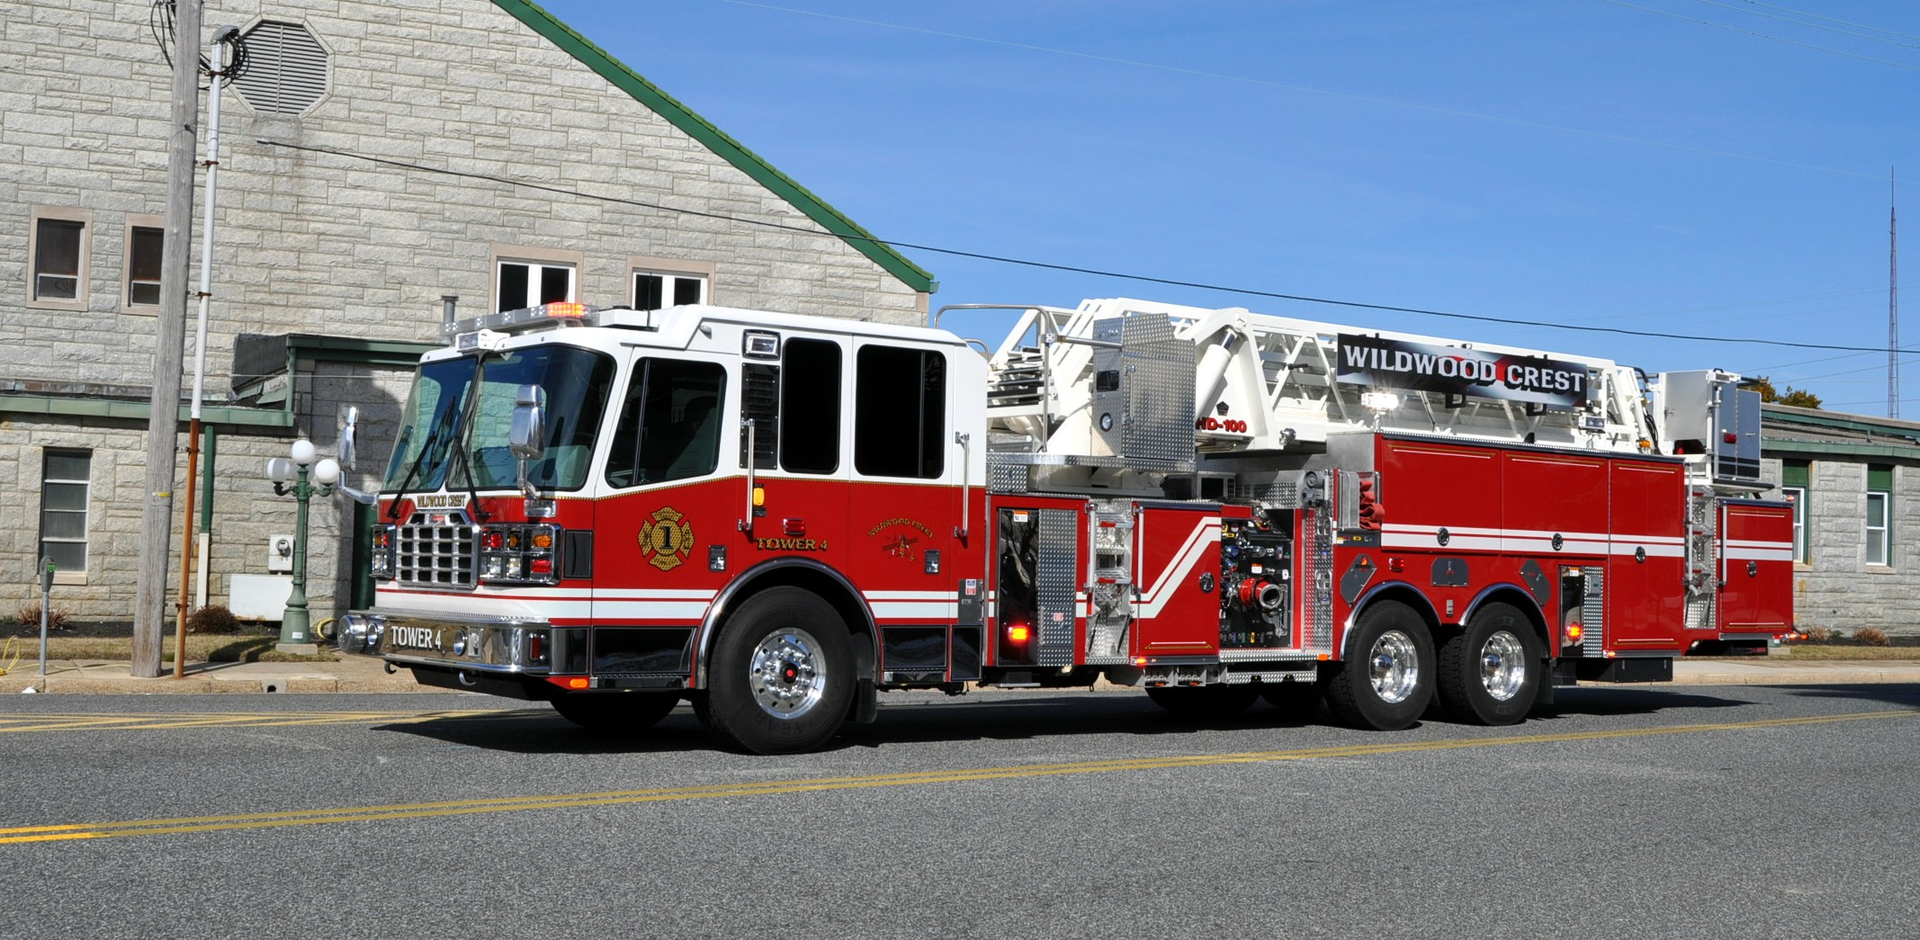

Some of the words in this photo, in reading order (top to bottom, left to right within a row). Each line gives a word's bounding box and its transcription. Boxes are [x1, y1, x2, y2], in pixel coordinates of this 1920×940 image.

[1343, 344, 1497, 382] WILDWOOD
[1506, 364, 1585, 393] CREST
[1195, 417, 1247, 433] HD-100
[659, 525, 674, 549] 1
[756, 538, 816, 551] TOWER
[819, 539, 828, 551] 4
[391, 625, 433, 649] TOWER
[435, 629, 442, 650] 4
